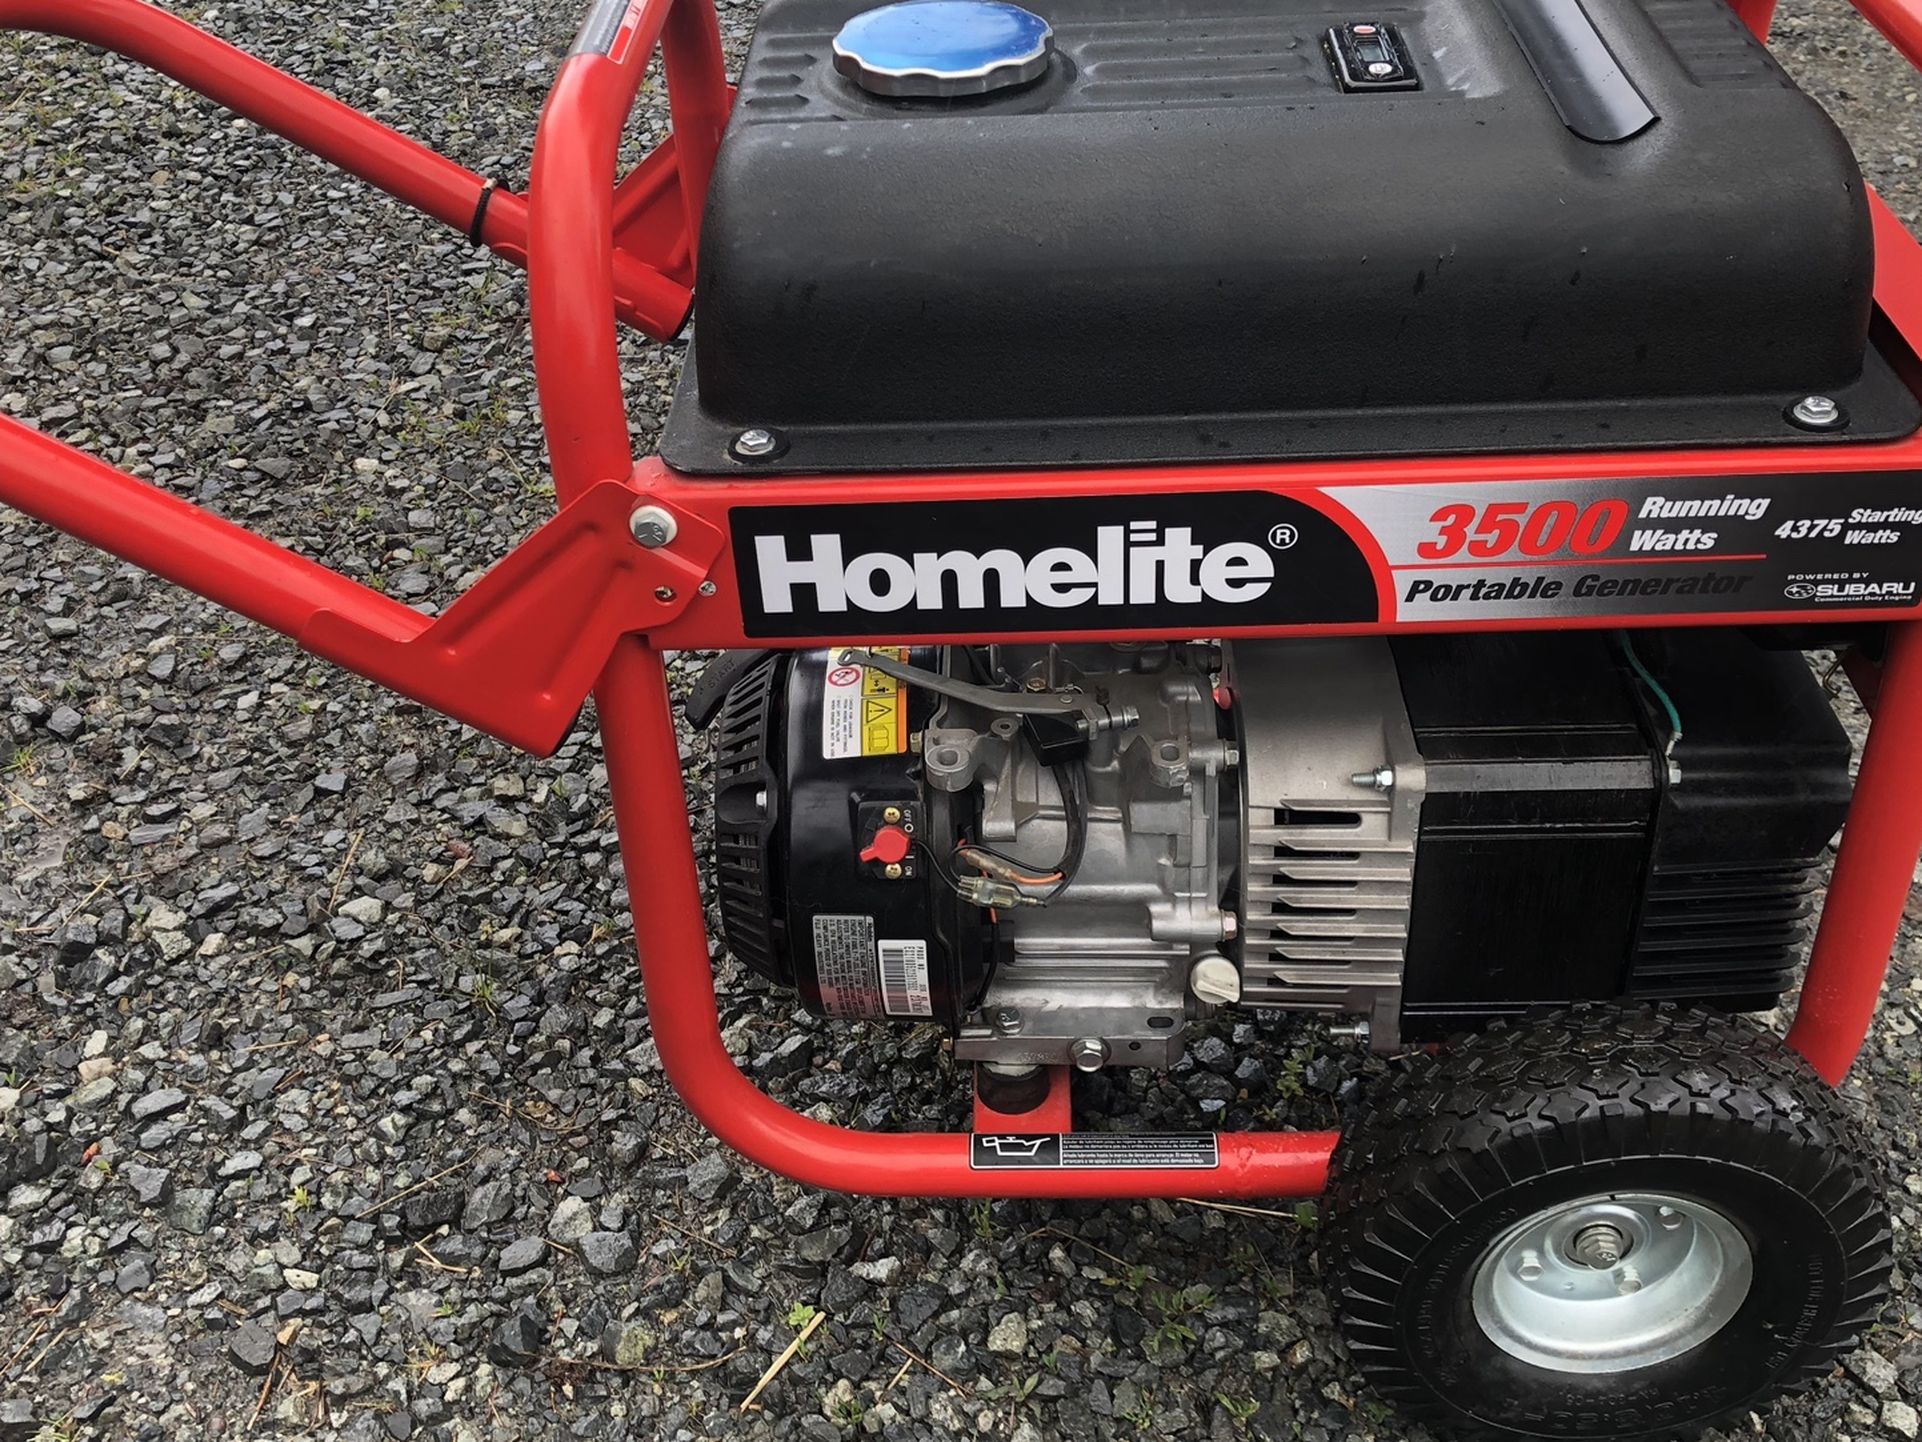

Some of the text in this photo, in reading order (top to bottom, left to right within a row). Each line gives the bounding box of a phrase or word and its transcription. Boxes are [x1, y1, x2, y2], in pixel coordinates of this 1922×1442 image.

[1416, 494, 1771, 560] 3500 Running
[1774, 507, 1922, 539] 4375 Starting
[1629, 527, 1718, 553] Watts
[1844, 529, 1901, 545] Watts
[1404, 569, 1753, 605] Portable Generator
[1787, 573, 1849, 581] POWERED
[1815, 581, 1916, 596] SUBARU
